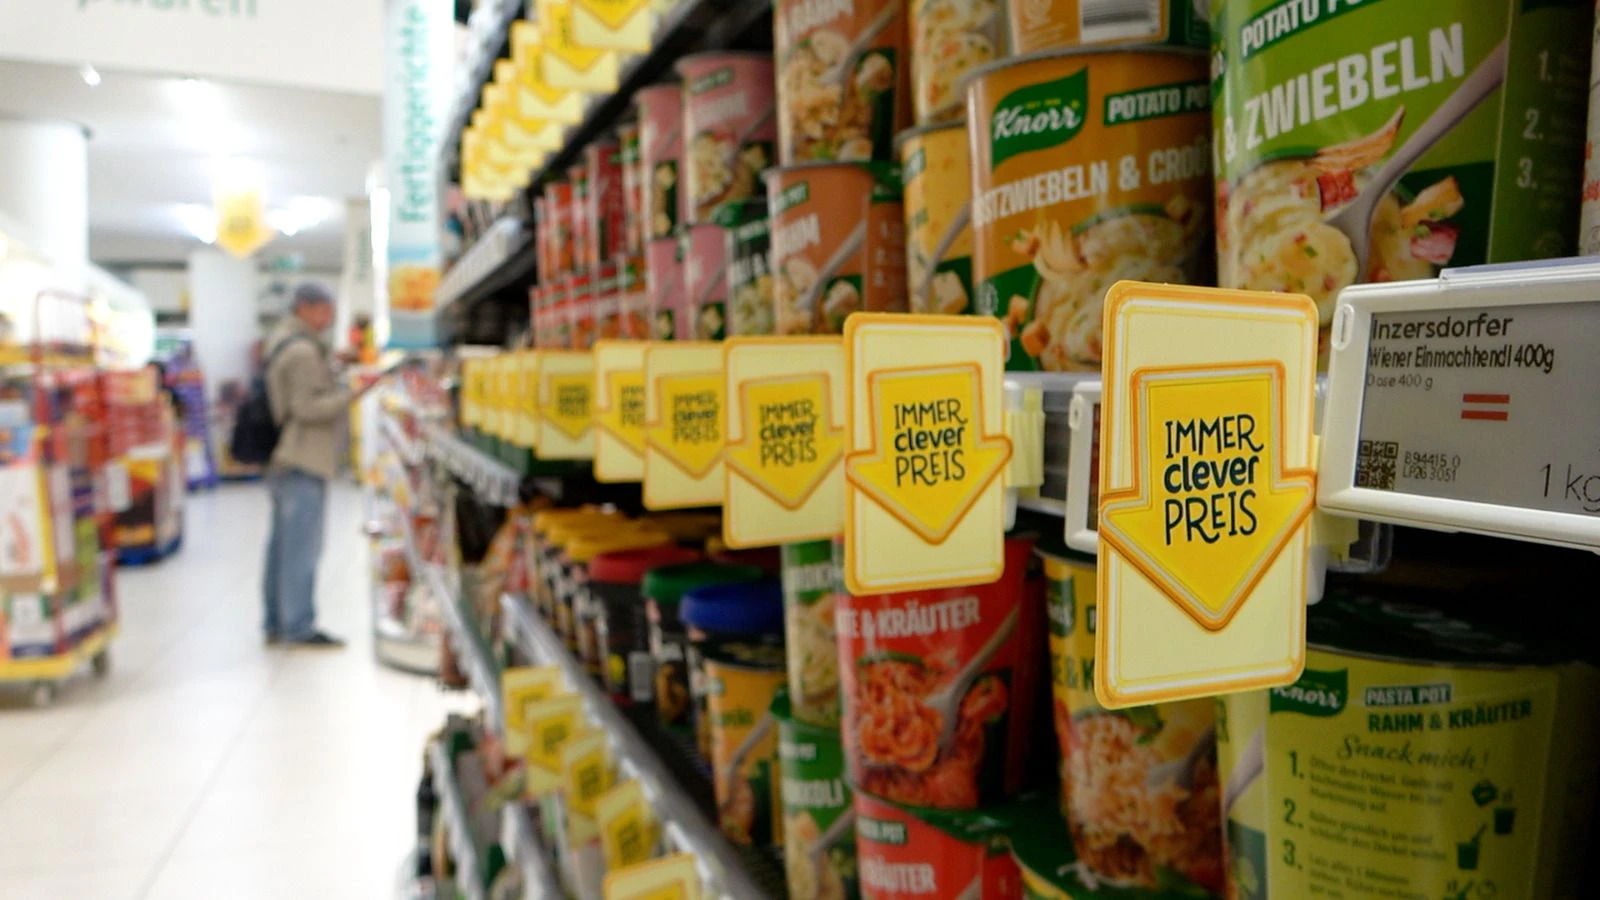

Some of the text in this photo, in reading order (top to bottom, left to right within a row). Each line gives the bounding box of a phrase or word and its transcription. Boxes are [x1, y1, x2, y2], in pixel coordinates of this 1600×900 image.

[1242, 0, 1320, 57] POTATO
[1108, 84, 1209, 122] POTATO PO
[1244, 22, 1466, 150] ZWIEBELN
[993, 104, 1081, 140] Knorr
[1118, 154, 1141, 192] &
[1372, 313, 1514, 340] Inzersdorfer
[1368, 343, 1555, 374] Wiener Einmachhendl 400g
[1398, 374, 1422, 388] 400
[1425, 376, 1434, 391] g
[760, 399, 818, 424] IMMER
[893, 398, 968, 431] IMMER
[760, 421, 815, 441] clever
[894, 425, 966, 453] clever
[1165, 413, 1264, 459] IMMER
[761, 438, 818, 468] PREIS
[895, 450, 966, 487] PREIS
[1163, 455, 1260, 494] clever
[1539, 462, 1552, 499] 1
[1164, 488, 1258, 546] PREIS
[876, 595, 981, 639] KRÄUTER
[1366, 683, 1449, 707] PASTA POT
[1368, 698, 1532, 733] RAHM & KRÄUTER
[1289, 749, 1305, 781] 1.
[1336, 733, 1413, 767] Snack
[1283, 797, 1303, 829] 2.
[1281, 838, 1303, 870] 3.
